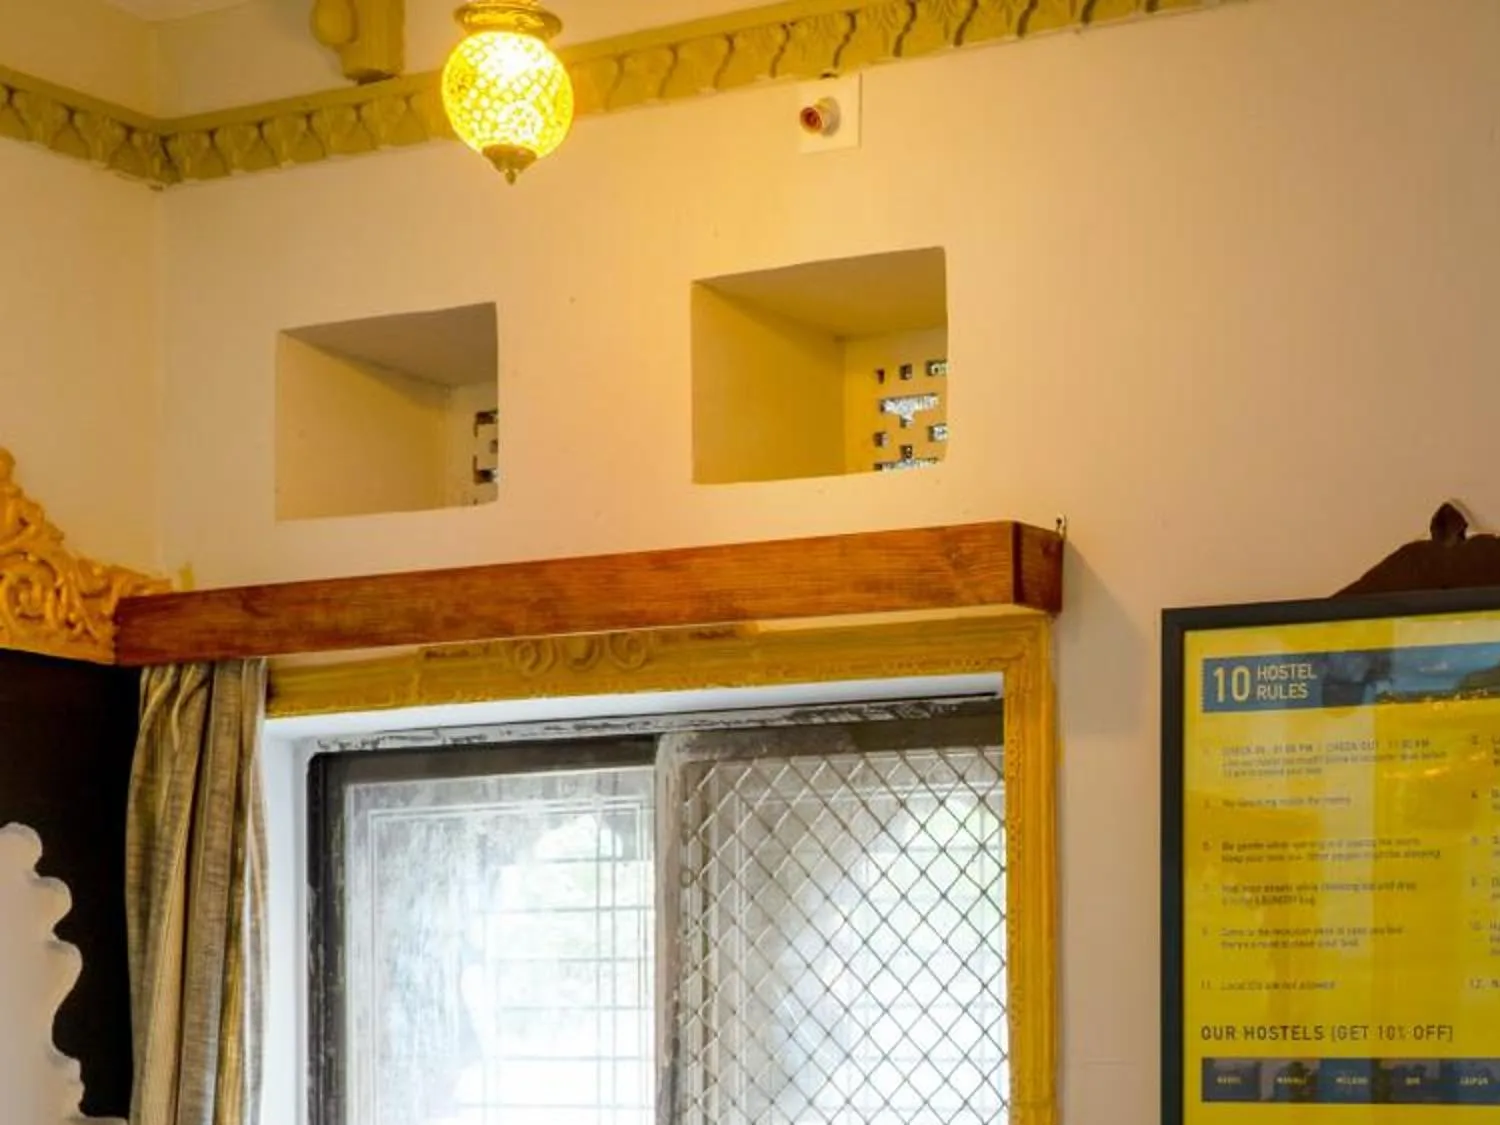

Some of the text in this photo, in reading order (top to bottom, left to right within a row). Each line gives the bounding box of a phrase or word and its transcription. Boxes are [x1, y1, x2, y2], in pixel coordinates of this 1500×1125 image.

[1257, 664, 1317, 680] HOSTEL
[1214, 666, 1250, 702] 10
[1257, 683, 1309, 700] RULES
[1201, 1025, 1236, 1041] OUR
[1243, 1024, 1323, 1041] HOSTELS
